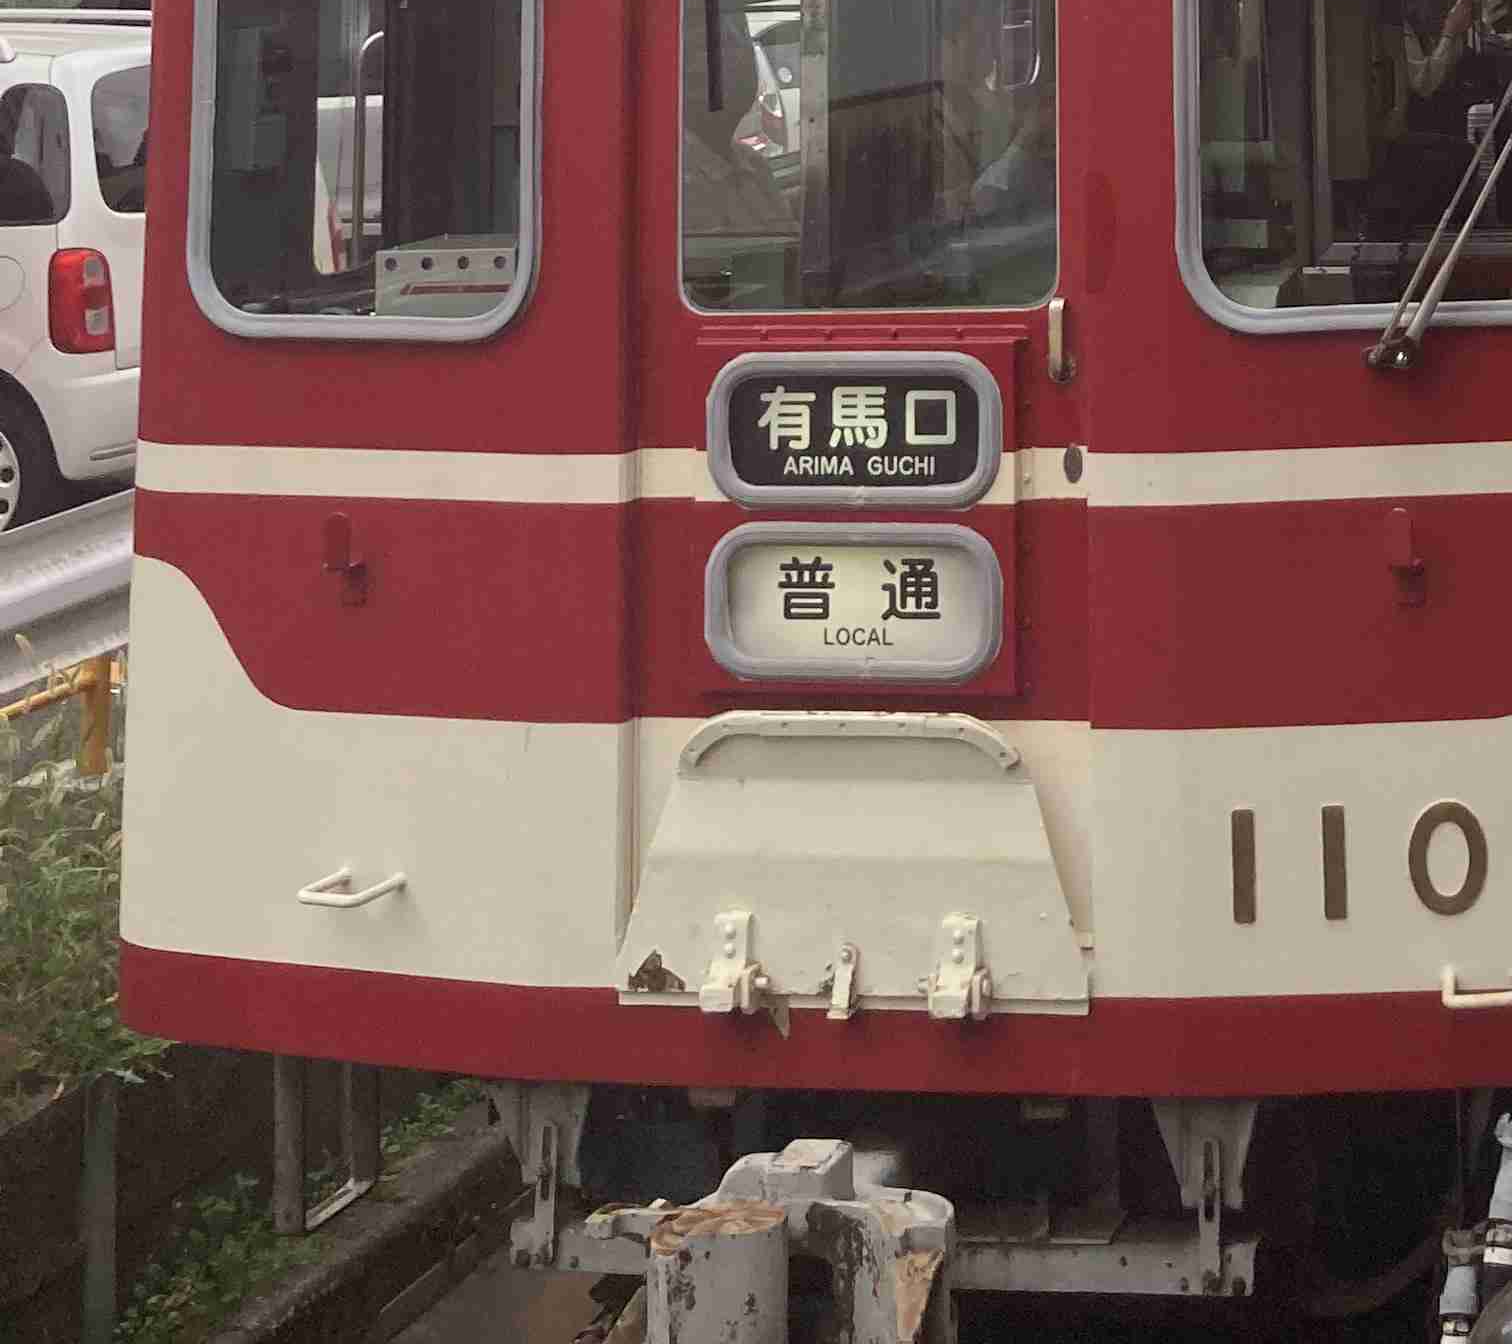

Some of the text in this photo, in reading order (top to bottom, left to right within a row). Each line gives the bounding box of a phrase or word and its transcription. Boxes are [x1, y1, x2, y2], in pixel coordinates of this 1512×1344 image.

[758, 386, 957, 450] 有馬口
[784, 455, 936, 476] ARIMA GUCHI
[778, 556, 941, 621] 普通
[823, 627, 894, 647] LOCAL
